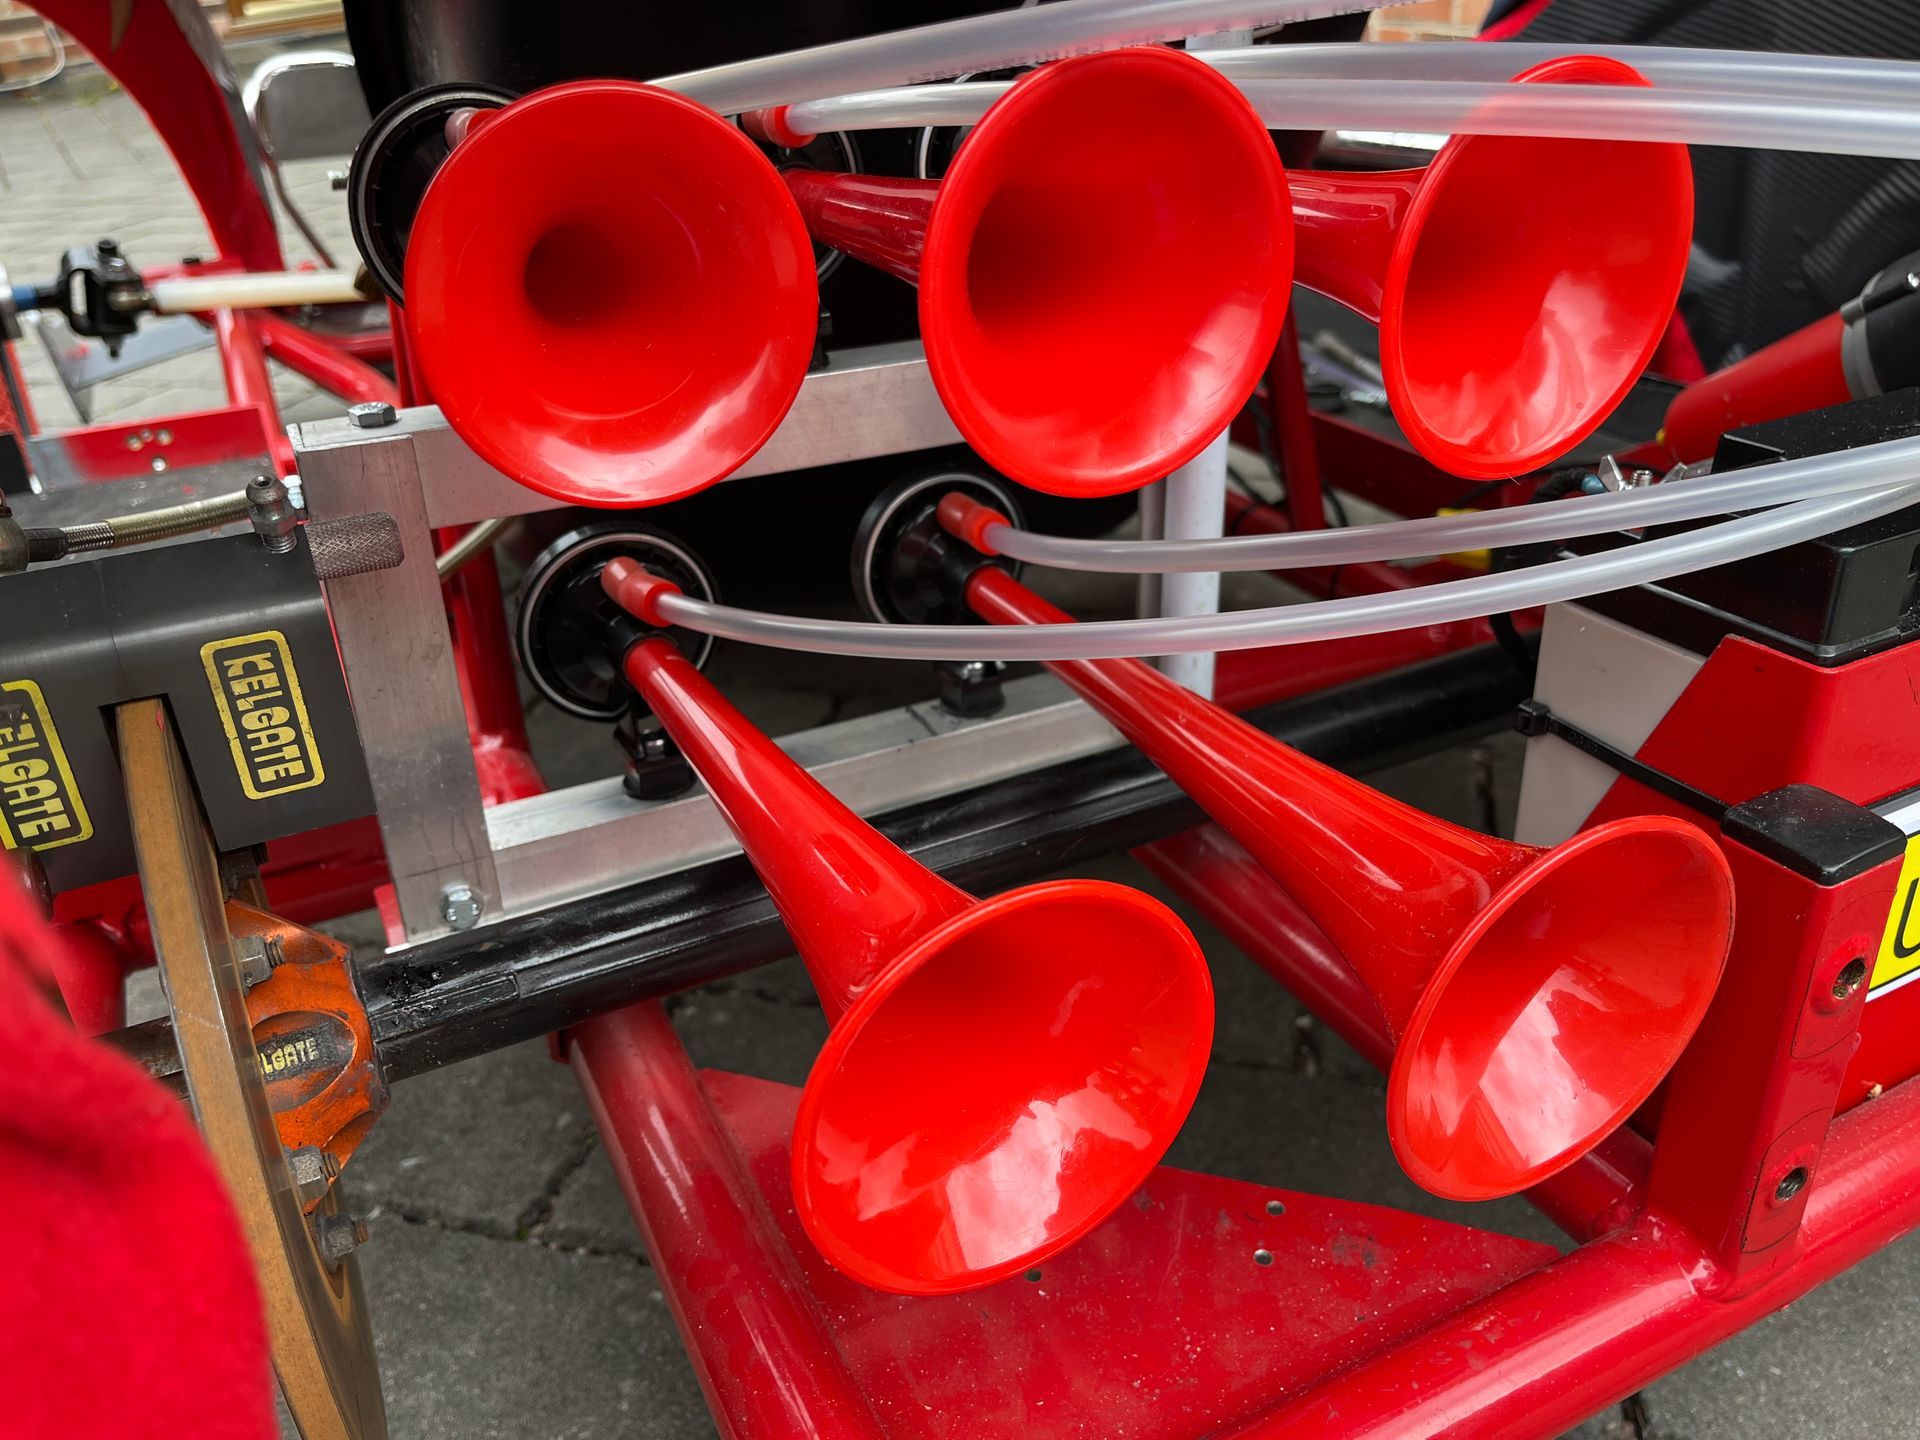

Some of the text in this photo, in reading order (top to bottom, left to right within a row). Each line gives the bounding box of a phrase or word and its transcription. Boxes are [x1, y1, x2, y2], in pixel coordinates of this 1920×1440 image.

[0, 711, 71, 839] ELGATE
[223, 652, 306, 783] KELGATE
[257, 1037, 320, 1075] LGATE
